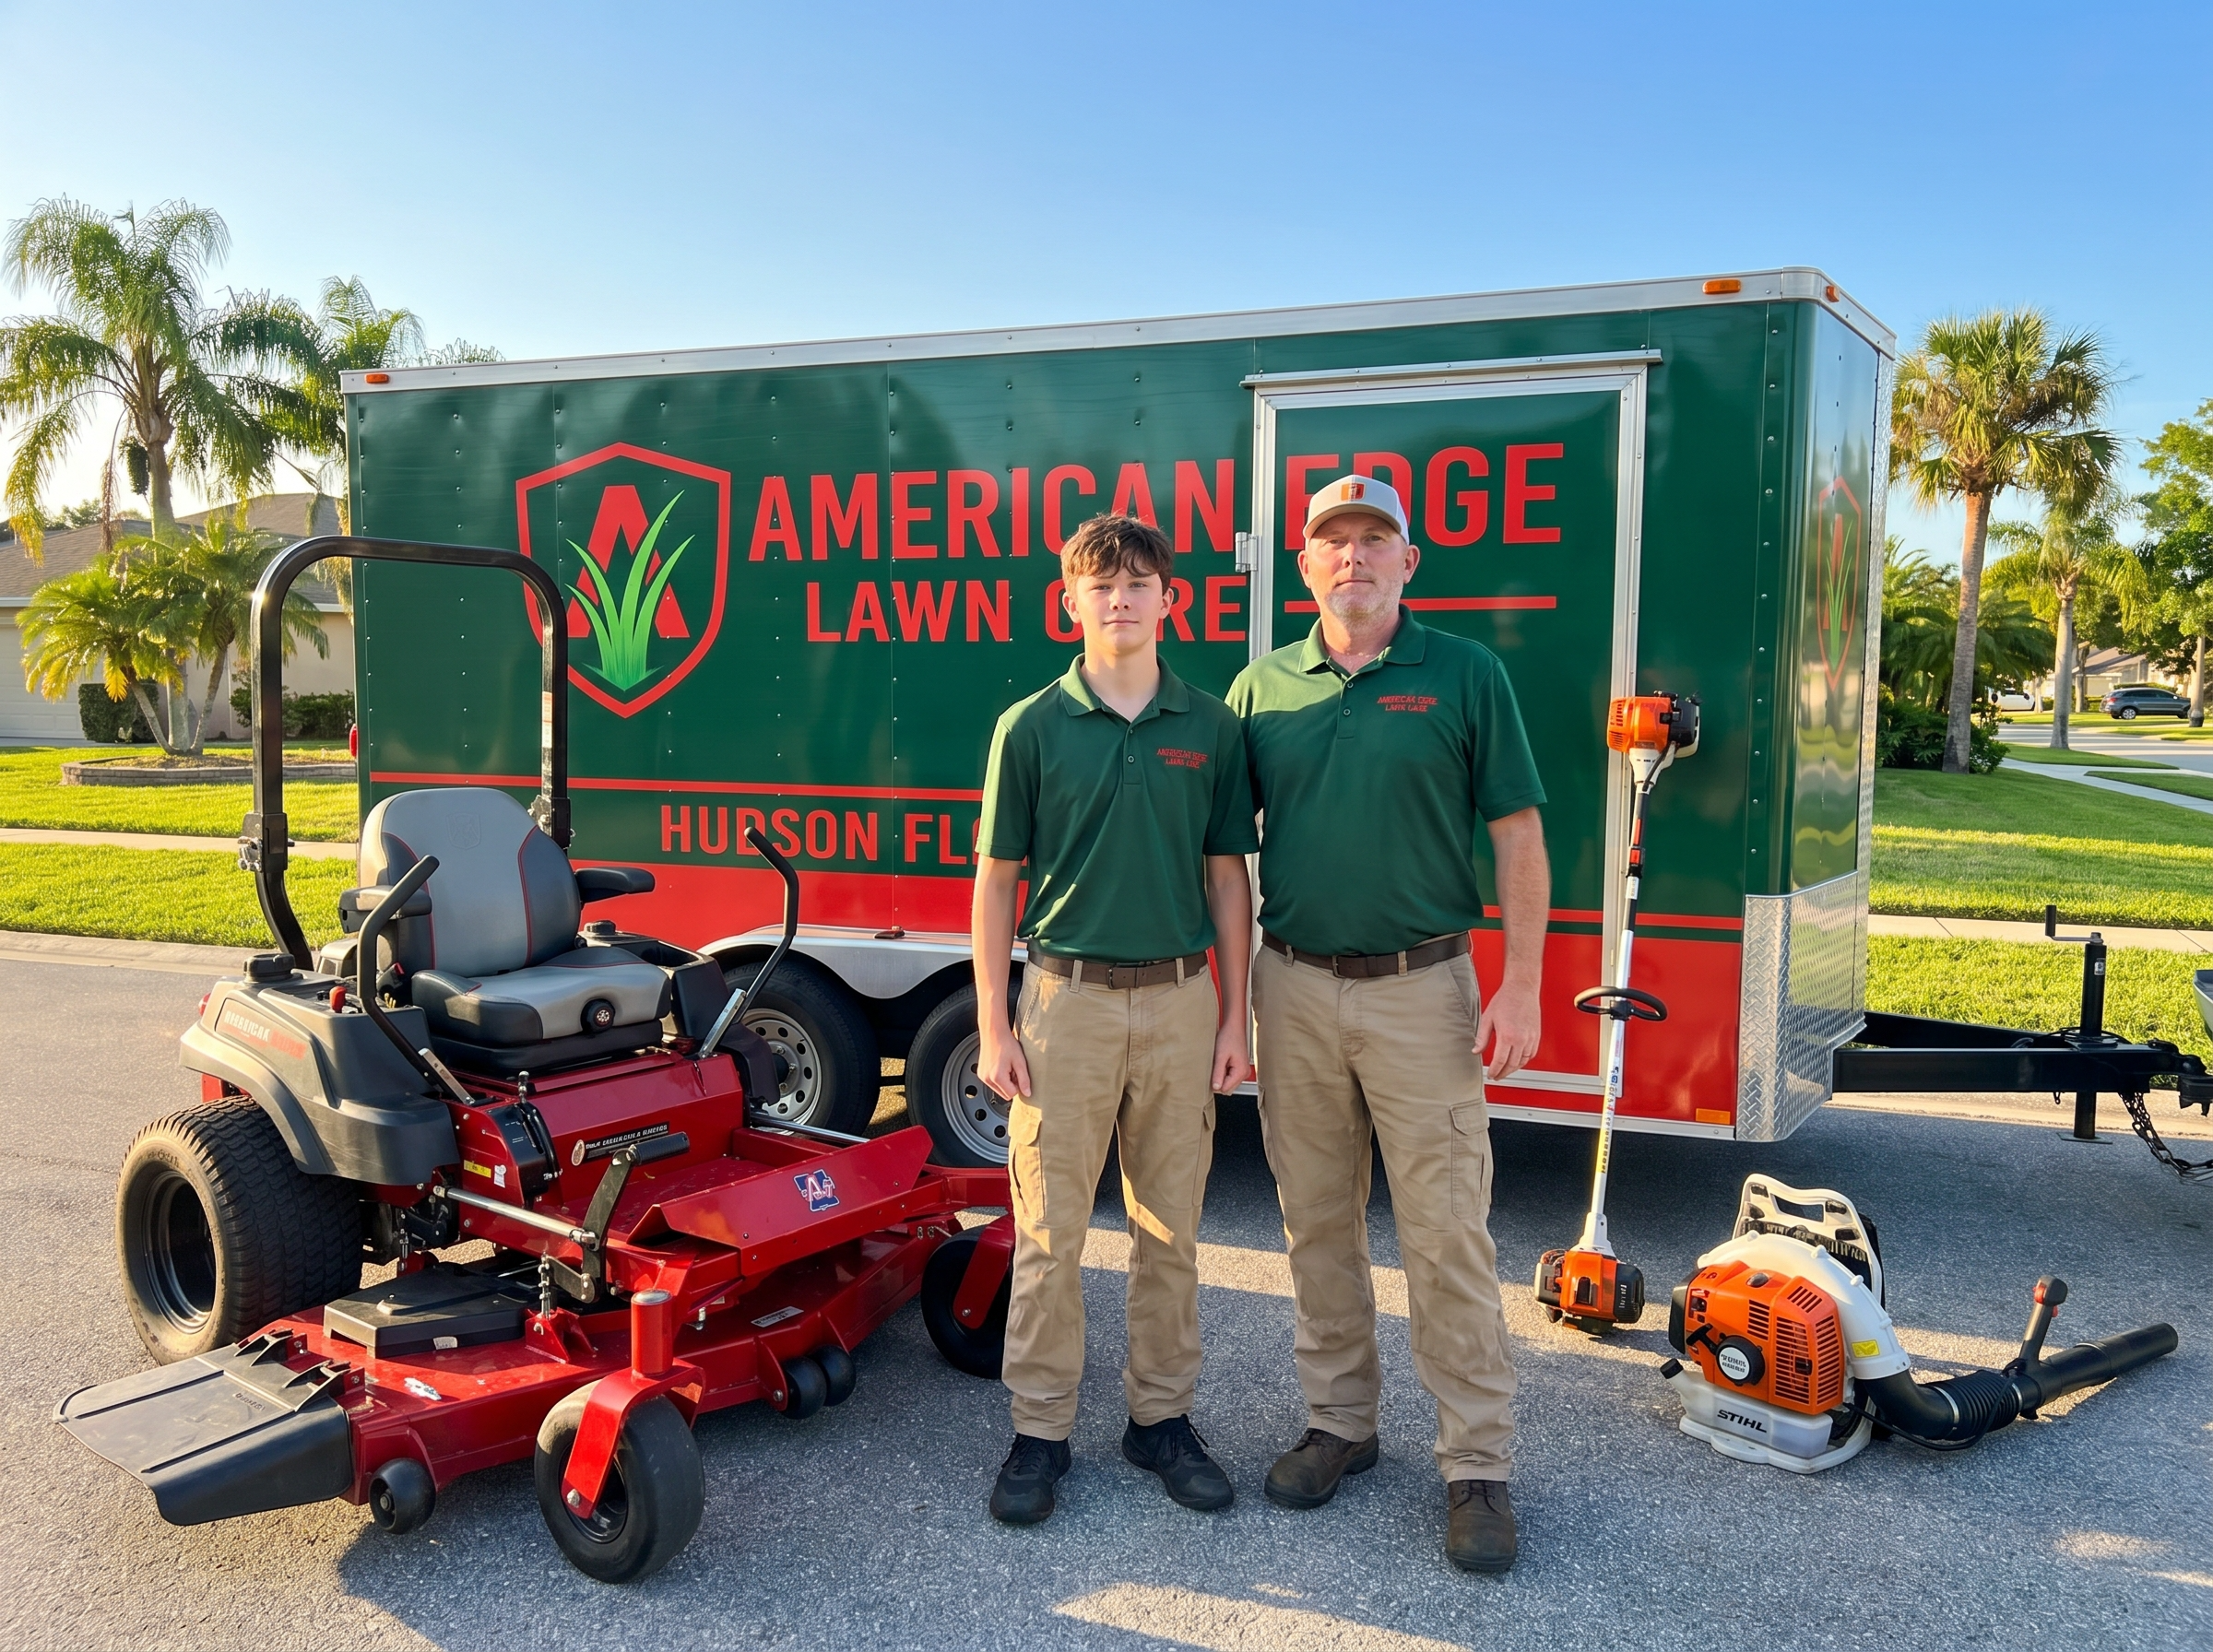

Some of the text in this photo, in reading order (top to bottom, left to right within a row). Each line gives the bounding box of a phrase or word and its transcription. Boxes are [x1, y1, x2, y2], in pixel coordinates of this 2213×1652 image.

[749, 459, 1236, 561] AMERICAN
[807, 575, 1248, 643] LAWN CRE
[661, 805, 878, 862] HUDSON
[1717, 1410, 1768, 1434] STIHL
